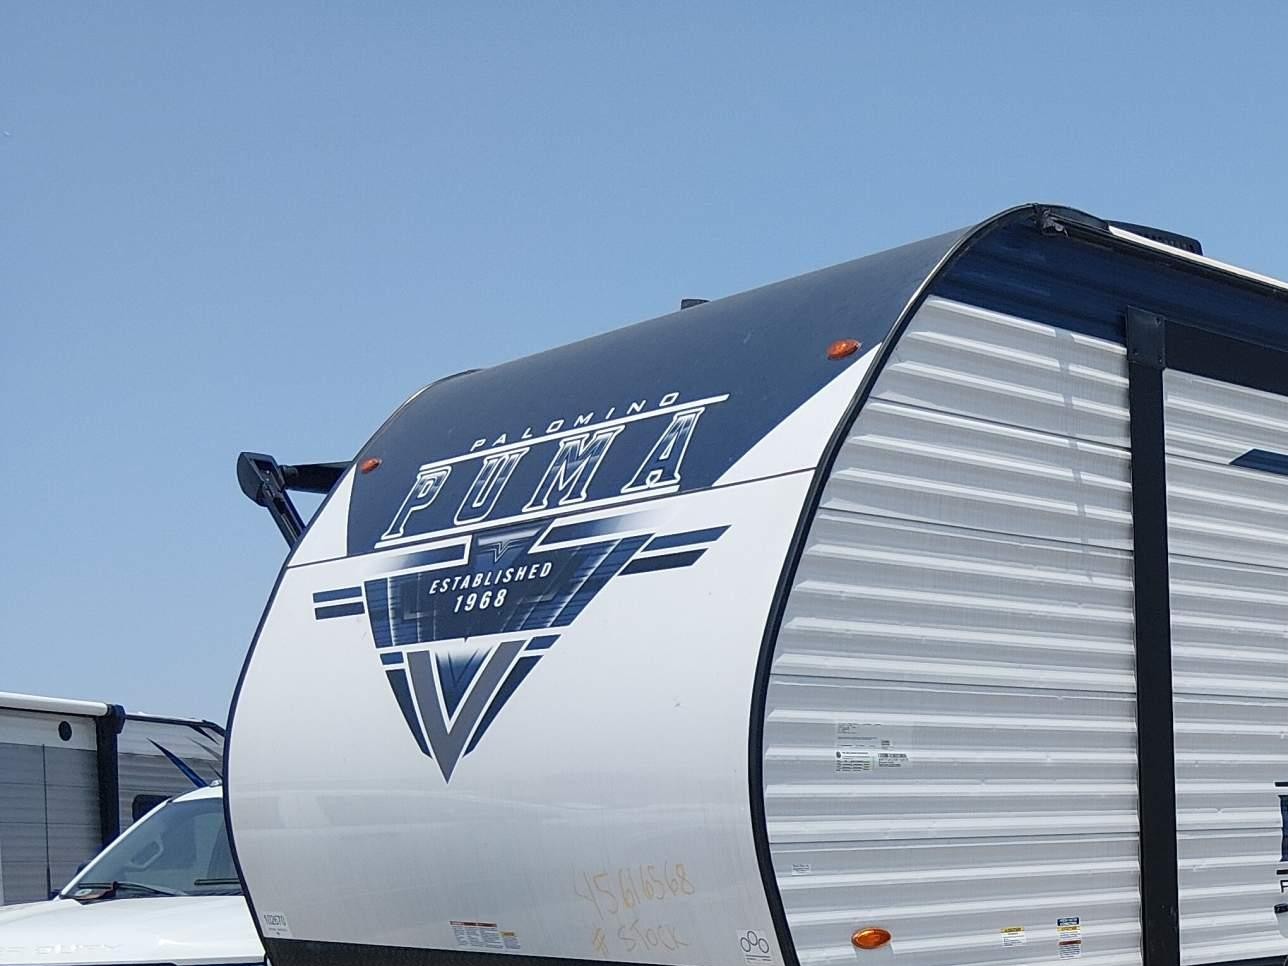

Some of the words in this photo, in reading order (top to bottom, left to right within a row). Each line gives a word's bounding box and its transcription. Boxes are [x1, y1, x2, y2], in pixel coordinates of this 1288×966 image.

[469, 391, 680, 452] PALOMINO
[380, 405, 706, 540] PUMA
[428, 562, 553, 595] ESTABLISHED
[453, 588, 508, 614] 1968
